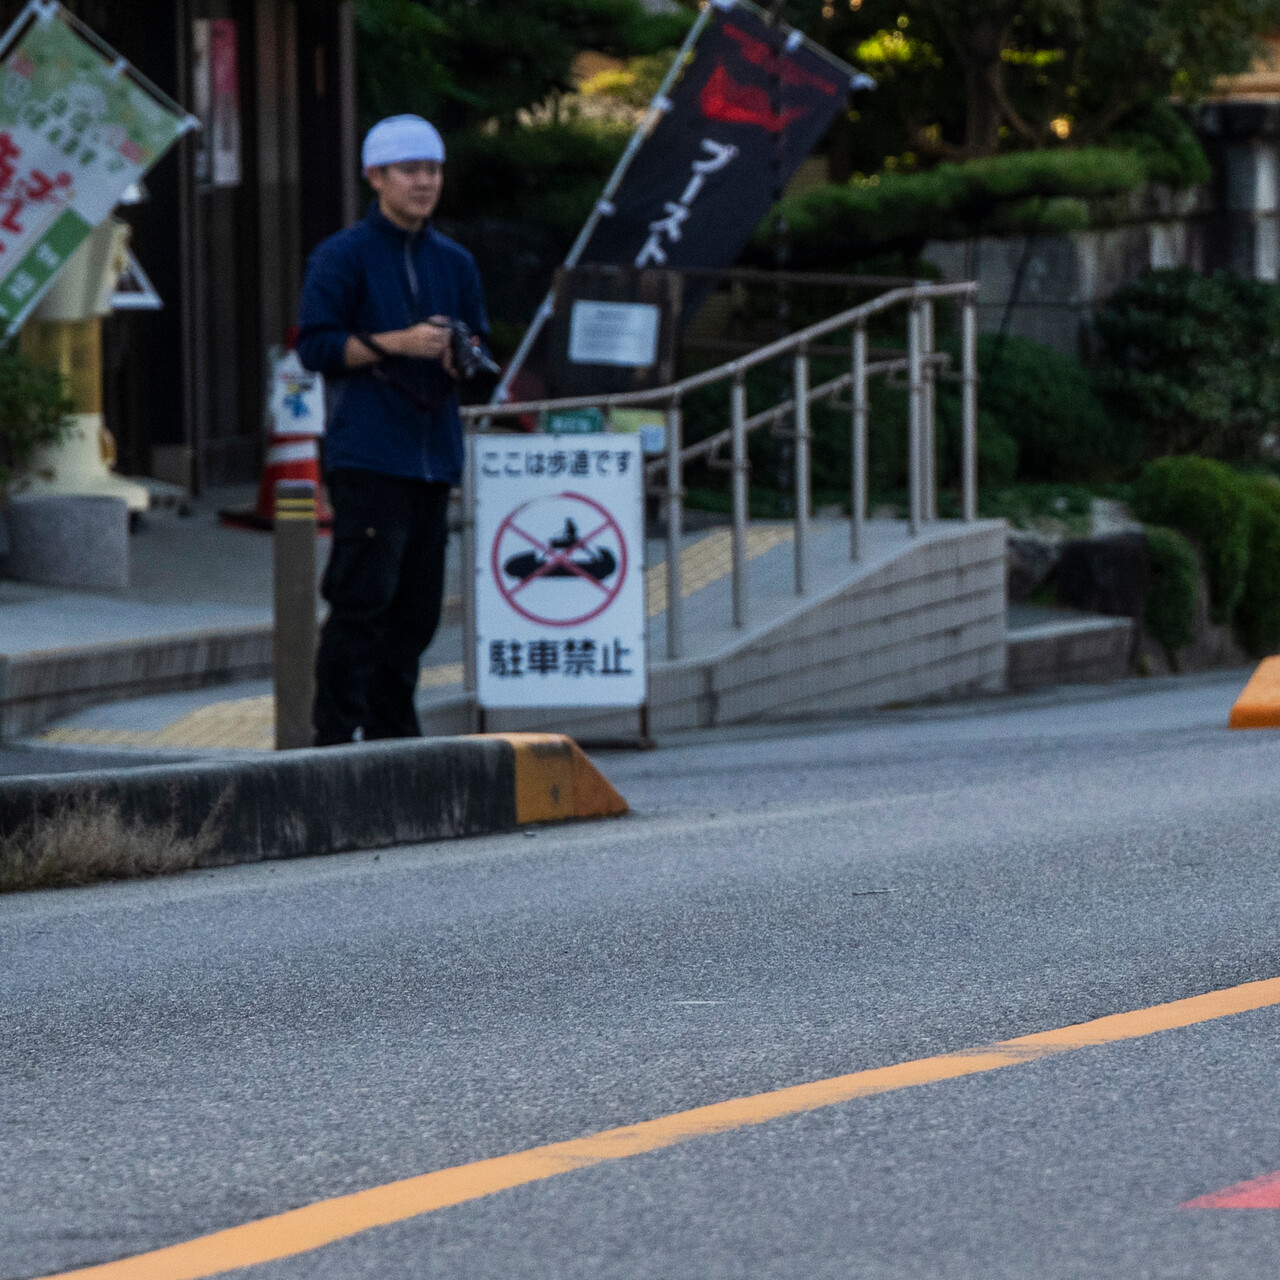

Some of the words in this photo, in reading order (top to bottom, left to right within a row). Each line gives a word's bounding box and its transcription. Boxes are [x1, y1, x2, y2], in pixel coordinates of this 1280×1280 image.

[482, 450, 632, 477] ここは歩道です
[489, 639, 633, 678] 駐車禁止
